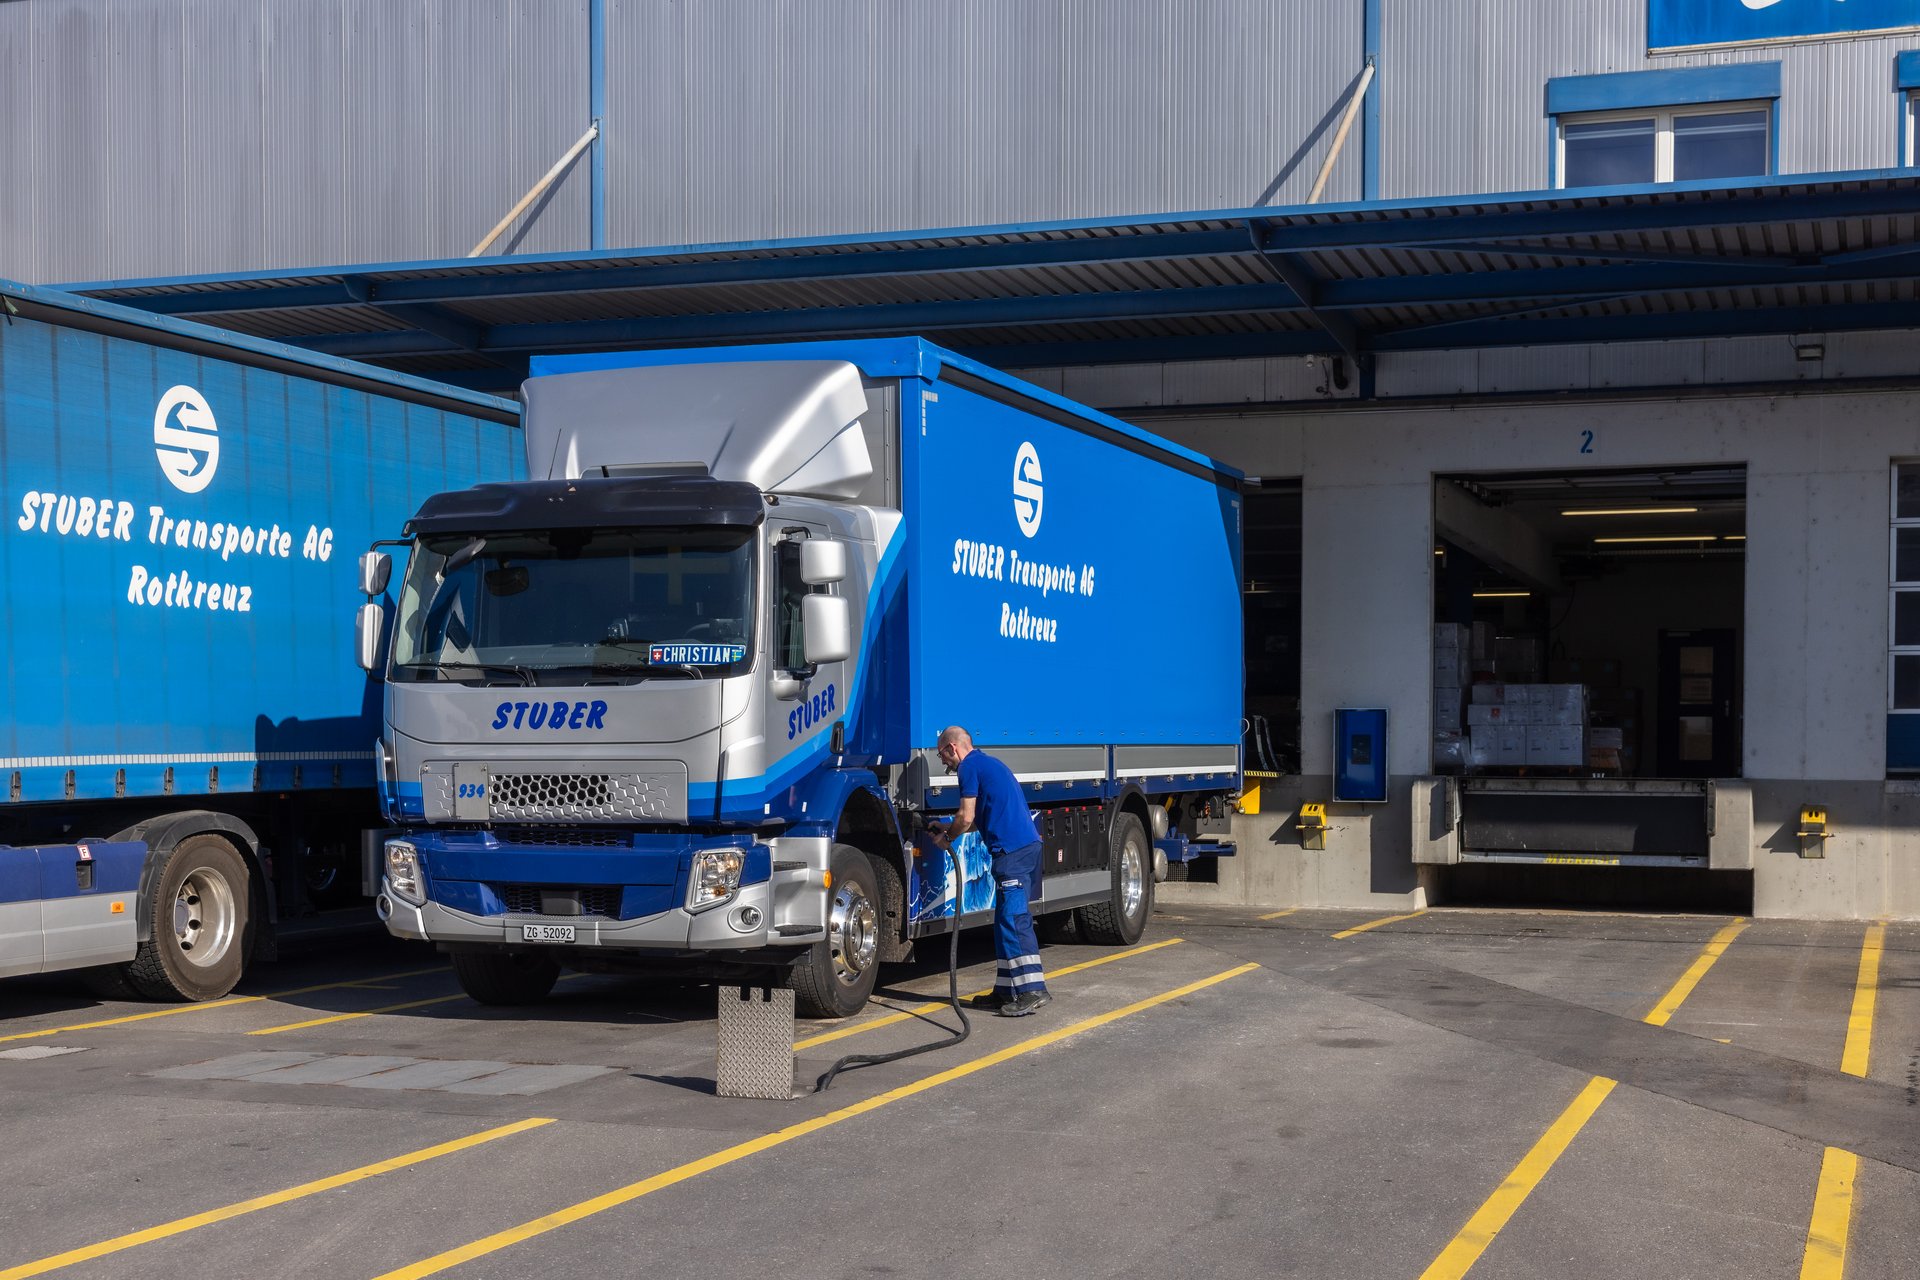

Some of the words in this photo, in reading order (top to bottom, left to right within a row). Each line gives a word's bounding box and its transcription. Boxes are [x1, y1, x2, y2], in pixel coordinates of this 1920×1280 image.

[1581, 430, 1593, 453] 2
[18, 491, 134, 543] STUBER
[149, 506, 291, 564] Transporte
[303, 525, 333, 561] AG
[953, 539, 1004, 581] STUBER
[1010, 550, 1075, 597] Transporte
[1080, 565, 1094, 596] AG
[128, 566, 252, 611] Rotkreuz
[1000, 603, 1056, 642] Rotkreuz
[663, 647, 730, 662] CHRISTIAN
[492, 700, 607, 730] STUBER
[788, 683, 835, 740] STUBER
[459, 783, 485, 798] 934
